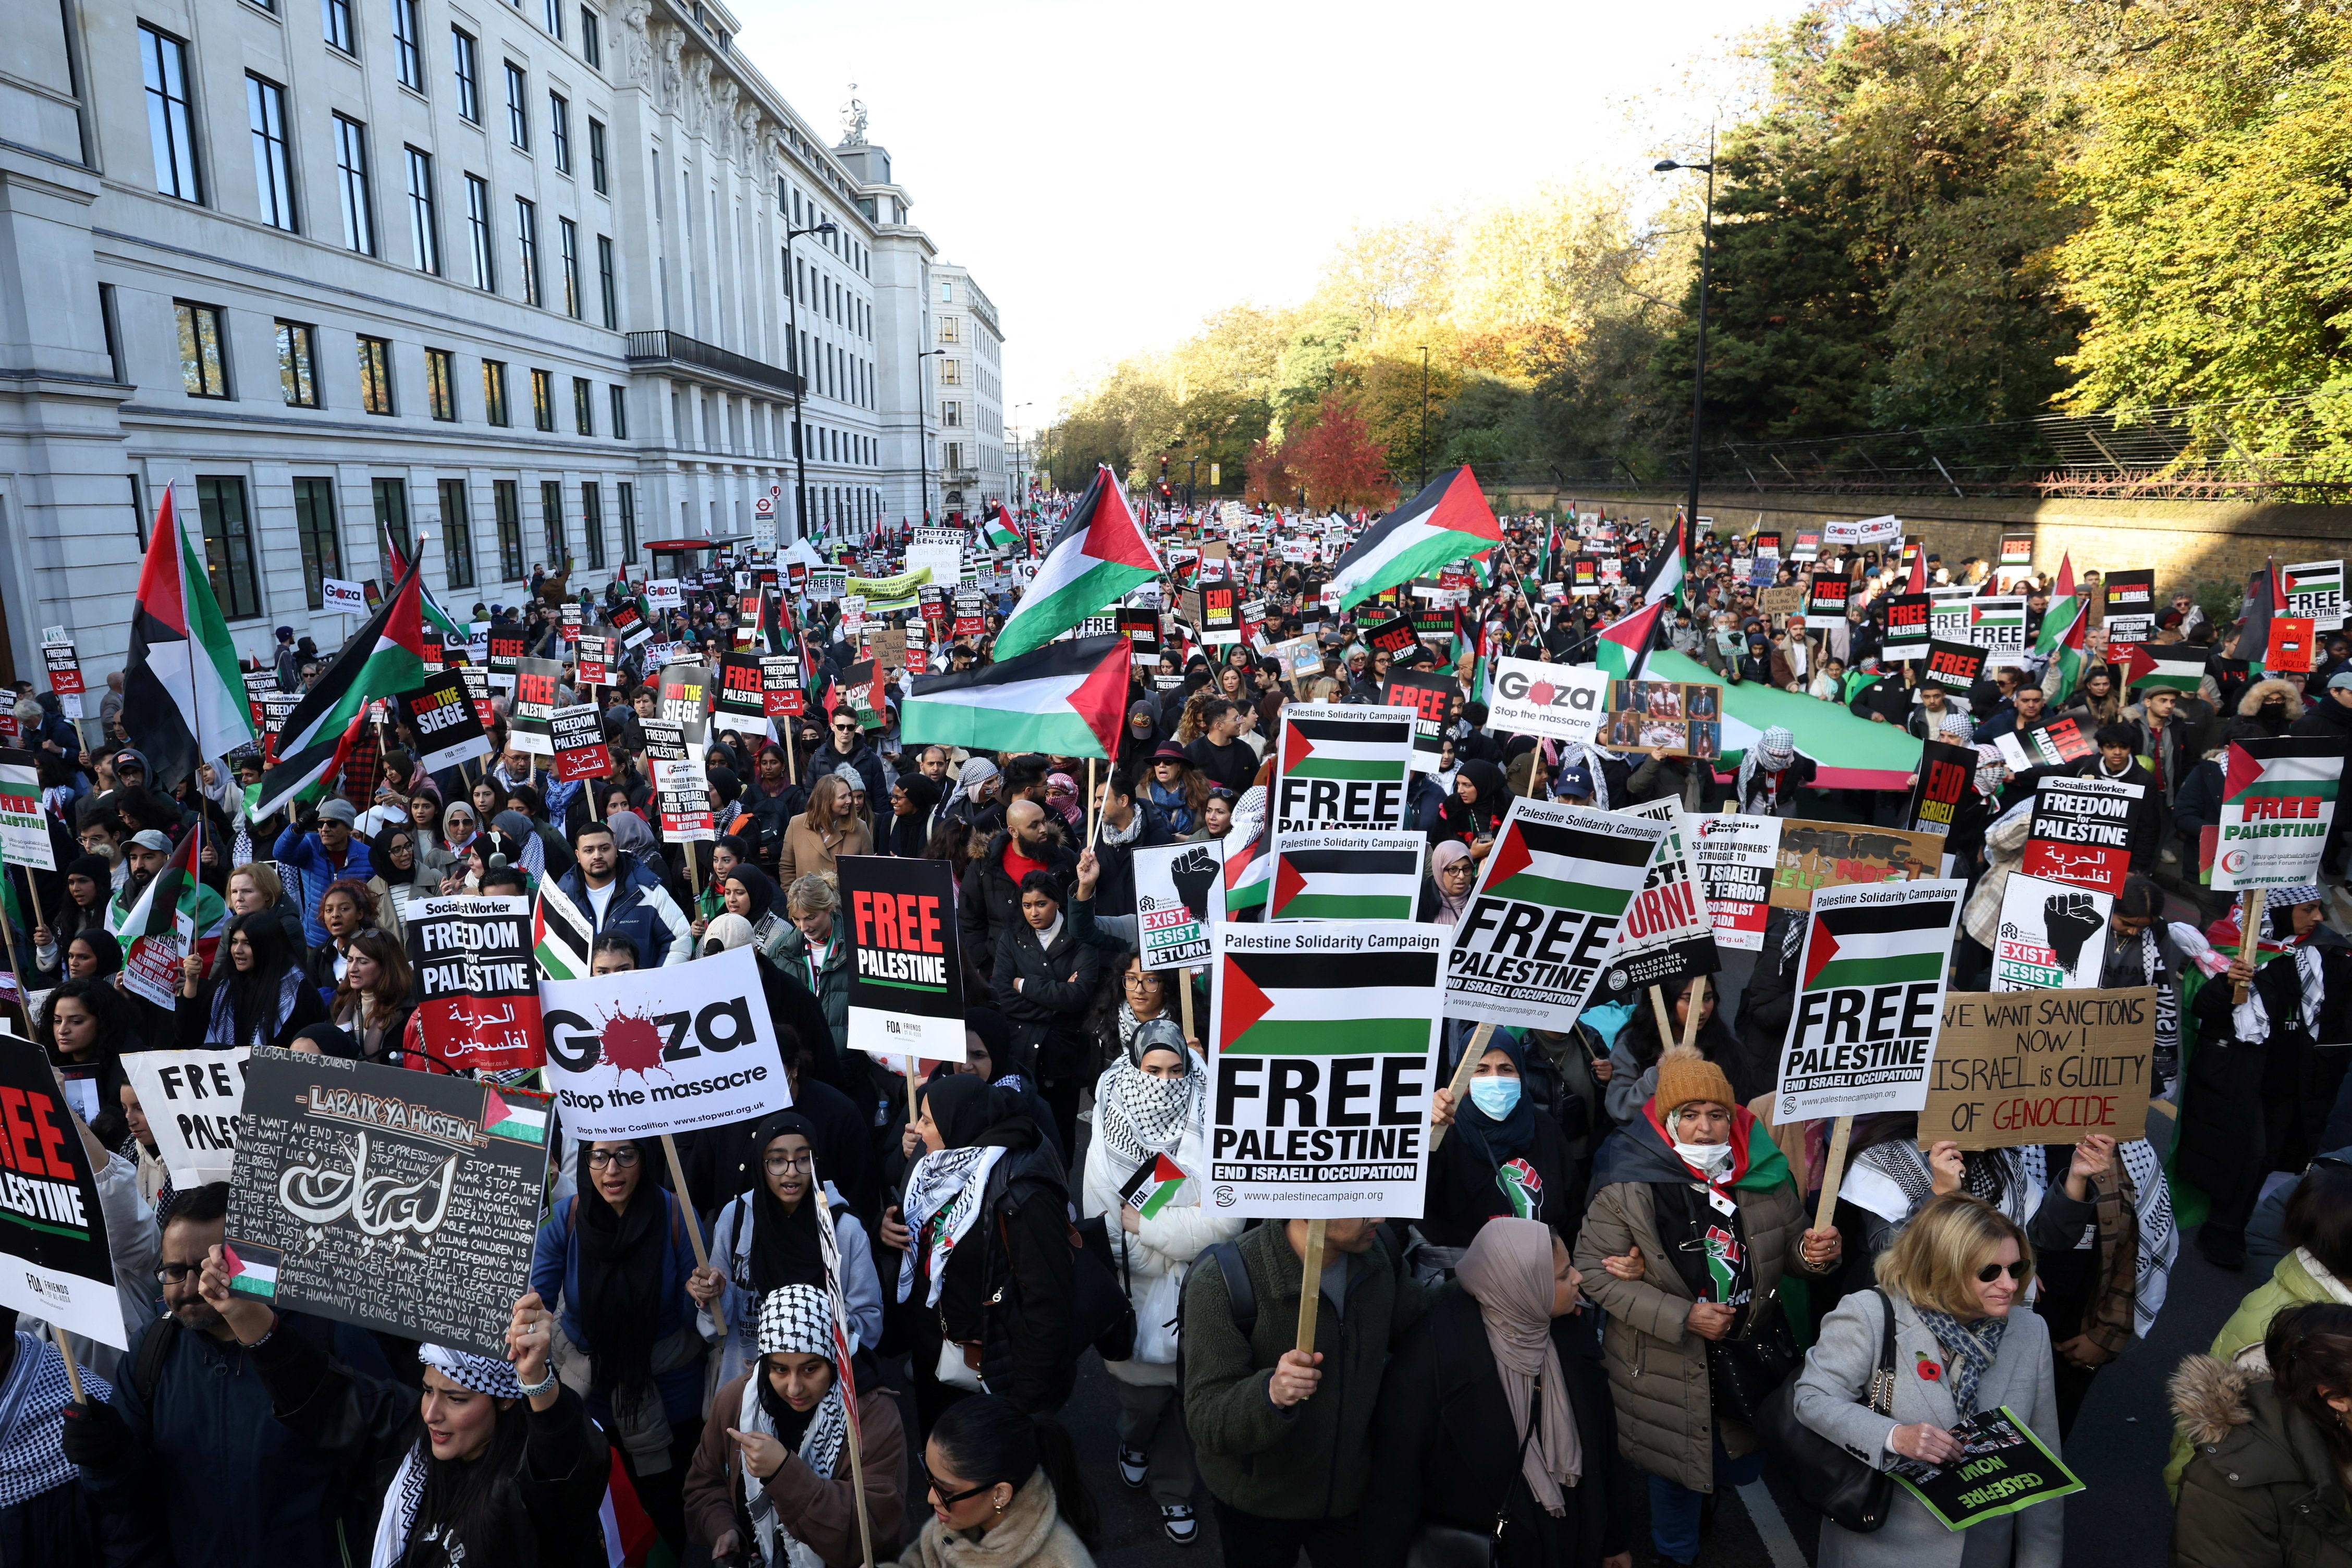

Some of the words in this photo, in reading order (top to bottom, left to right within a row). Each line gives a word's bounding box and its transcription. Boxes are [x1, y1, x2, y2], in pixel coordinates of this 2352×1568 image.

[1798, 535, 1819, 543] FREE
[790, 568, 804, 578] FREE
[1576, 562, 1594, 572] END
[889, 574, 920, 587] PALESTINE!
[891, 579, 924, 591] PALESTINE!
[2109, 583, 2149, 593] SANCTIONS
[1206, 589, 1232, 608] END
[1767, 589, 1783, 597] STOP
[1814, 582, 1847, 599] FREE
[2109, 592, 2120, 601] ON
[2121, 590, 2150, 602] ISRAEL
[1207, 606, 1231, 618] ISRAELI
[1812, 598, 1846, 609] PALESTINE
[613, 607, 640, 629] FREE
[1207, 616, 1232, 624] APARTHEID
[1424, 612, 1442, 621] FREE
[1888, 604, 1927, 626] FREE
[1888, 624, 1928, 639] PALESTINE
[1970, 627, 2022, 643] FREE
[2113, 622, 2147, 632] FREEDOM
[2111, 632, 2148, 642] PALESTINE
[46, 648, 72, 659] FREEDOM
[48, 660, 78, 671] PALESTINE
[764, 665, 795, 676] FREEDOM
[1931, 652, 1980, 677] FREE
[2272, 659, 2309, 668] GENOCIDE
[764, 679, 799, 690] PALESTINE
[1926, 669, 1975, 688] PALESTINE
[1499, 672, 1596, 711] Gza
[416, 702, 468, 734] SIEGE
[663, 700, 700, 724] SIEGE
[1494, 705, 1519, 719] Stop
[1521, 709, 1537, 720] the
[1539, 715, 1591, 728] massacre
[552, 714, 596, 733] FREEDOM
[554, 731, 603, 751] PALESTINE
[664, 792, 677, 802] END
[678, 791, 705, 802] ISRAELI
[1279, 779, 1402, 822] FREE
[2043, 792, 2129, 818] FREEDOM
[662, 801, 682, 812] STATE
[683, 801, 709, 812] TERROR
[2242, 796, 2323, 822] FREE
[667, 814, 676, 823] FOR
[682, 812, 708, 822] SOCIALIST
[677, 822, 701, 830] INTIFADA
[1516, 805, 1564, 824] Palestine
[1565, 815, 1614, 835] Solidarity
[1616, 824, 1662, 839] Campaign
[1712, 820, 1759, 829] Socialist
[2076, 814, 2091, 824] for
[2034, 818, 2128, 847] PALESTINE
[2225, 822, 2328, 840] PALESTINE
[1281, 839, 1320, 849] Palestine
[1324, 837, 1369, 849] Solidarity
[1371, 838, 1418, 850] Campaign
[1704, 842, 1729, 851] UNITED
[1699, 852, 1734, 860] STRUGGLE
[2044, 846, 2105, 865] الحرية
[2234, 876, 2306, 885] WWW.PFBUK.COM
[1721, 885, 1766, 901] TERROR
[1817, 893, 1857, 908] Palestine
[1859, 892, 1906, 904] Solidarity
[1909, 887, 1958, 901] Campaign
[852, 890, 943, 953] FREE
[1142, 908, 1191, 928] EXIST.
[421, 921, 520, 952] FREEDOM
[1454, 897, 1620, 969] FREE
[1225, 934, 1290, 949] Palestine
[1295, 934, 1363, 951] Solidarity
[1368, 934, 1440, 949] Campaign
[466, 952, 479, 964] for
[858, 949, 947, 984] PALESTINE
[422, 963, 531, 995] PALESTINE
[1463, 980, 1509, 997] ISRAELI
[1511, 987, 1579, 1007] OCCUPATION
[448, 1003, 515, 1030] الحرية
[1791, 983, 1939, 1050] FREE
[1983, 1005, 2032, 1028] WANT
[2037, 998, 2146, 1026] SANCTIONS
[542, 995, 757, 1073] Gza
[887, 1021, 901, 1034] FOA
[444, 1028, 530, 1057] لفلسطين
[252, 1046, 289, 1060] GLOBAL
[291, 1051, 317, 1064] PEACE
[1785, 1039, 1929, 1076] PALESTINE
[1784, 1080, 1806, 1094] END
[1809, 1074, 1852, 1089] ISRAELI
[1854, 1069, 1921, 1086] OCCUPATION
[1931, 1057, 2036, 1091] ISRAEL
[2058, 1054, 2146, 1088] GUILTY
[559, 1089, 604, 1113] Stop
[608, 1089, 645, 1107] the
[651, 1065, 767, 1102] massacre
[1215, 1057, 1427, 1127] FREE
[1802, 1089, 1896, 1107] www.palestinecampaign.org
[311, 1088, 379, 1123] LABAIK
[385, 1102, 408, 1127] YA
[410, 1106, 475, 1143] HUSSEIN
[628, 1120, 669, 1132] Coalition
[673, 1101, 765, 1126] www.stopwar.org.uk
[1952, 1102, 1985, 1132] OF
[1993, 1095, 2119, 1130] GENOCIDE
[1213, 1128, 1420, 1161] PALESTINE
[464, 1160, 494, 1174] STOP
[497, 1166, 521, 1178] THE
[1215, 1166, 1248, 1180] END
[1252, 1166, 1313, 1181] ISRAELI
[1318, 1165, 1415, 1180] OCCUPATION
[457, 1172, 481, 1184] WAR.
[485, 1177, 517, 1191] STOP
[521, 1183, 541, 1195] THE
[453, 1184, 492, 1200] KILLING
[493, 1193, 510, 1202] OF
[1217, 1192, 1232, 1201] PSC
[1244, 1190, 1383, 1202] www.palestinecampaign.org
[255, 1331, 274, 1348] SAVE
[1957, 1455, 2008, 1481] NOW!
[1957, 1473, 2043, 1509] CEASEFIRE
